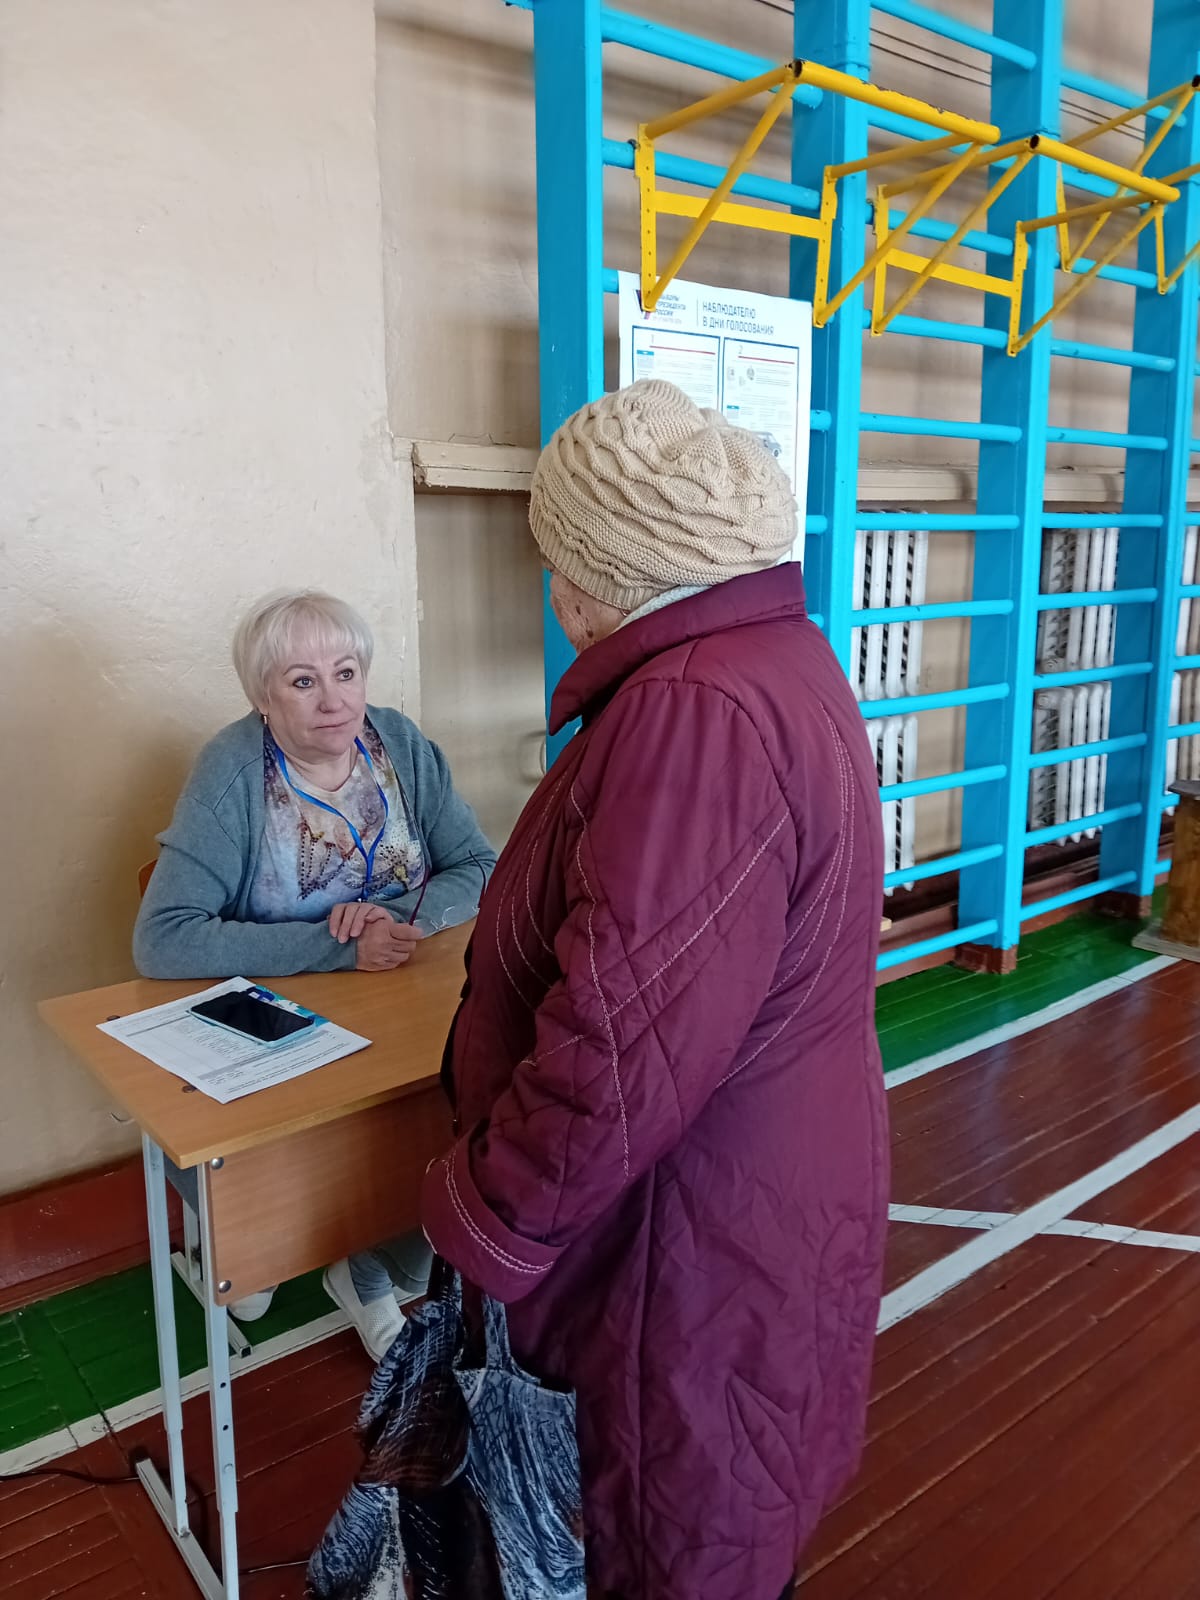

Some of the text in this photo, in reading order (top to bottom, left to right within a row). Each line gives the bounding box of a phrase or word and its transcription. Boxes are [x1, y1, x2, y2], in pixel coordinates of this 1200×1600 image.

[703, 302, 756, 319] НАБЛЮДАТЕЛЮ
[703, 316, 775, 335] В ДНИ ГОЛОСОВАНИЯ
